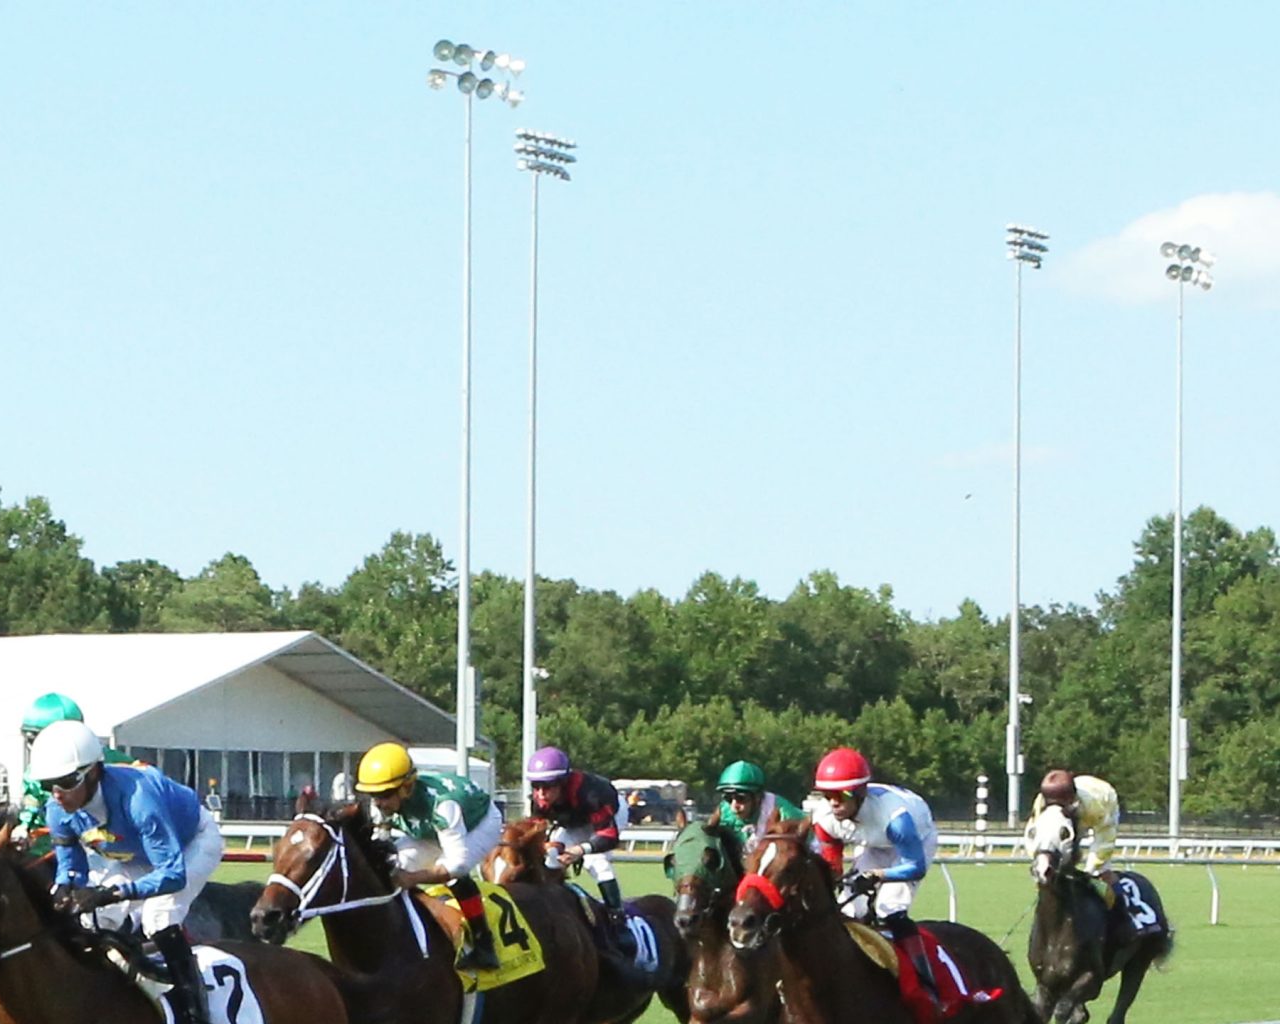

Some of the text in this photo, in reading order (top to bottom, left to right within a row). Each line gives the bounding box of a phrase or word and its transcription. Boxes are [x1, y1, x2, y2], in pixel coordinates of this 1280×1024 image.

[489, 892, 531, 951] 4
[626, 915, 658, 972] 10
[936, 944, 968, 996] 1
